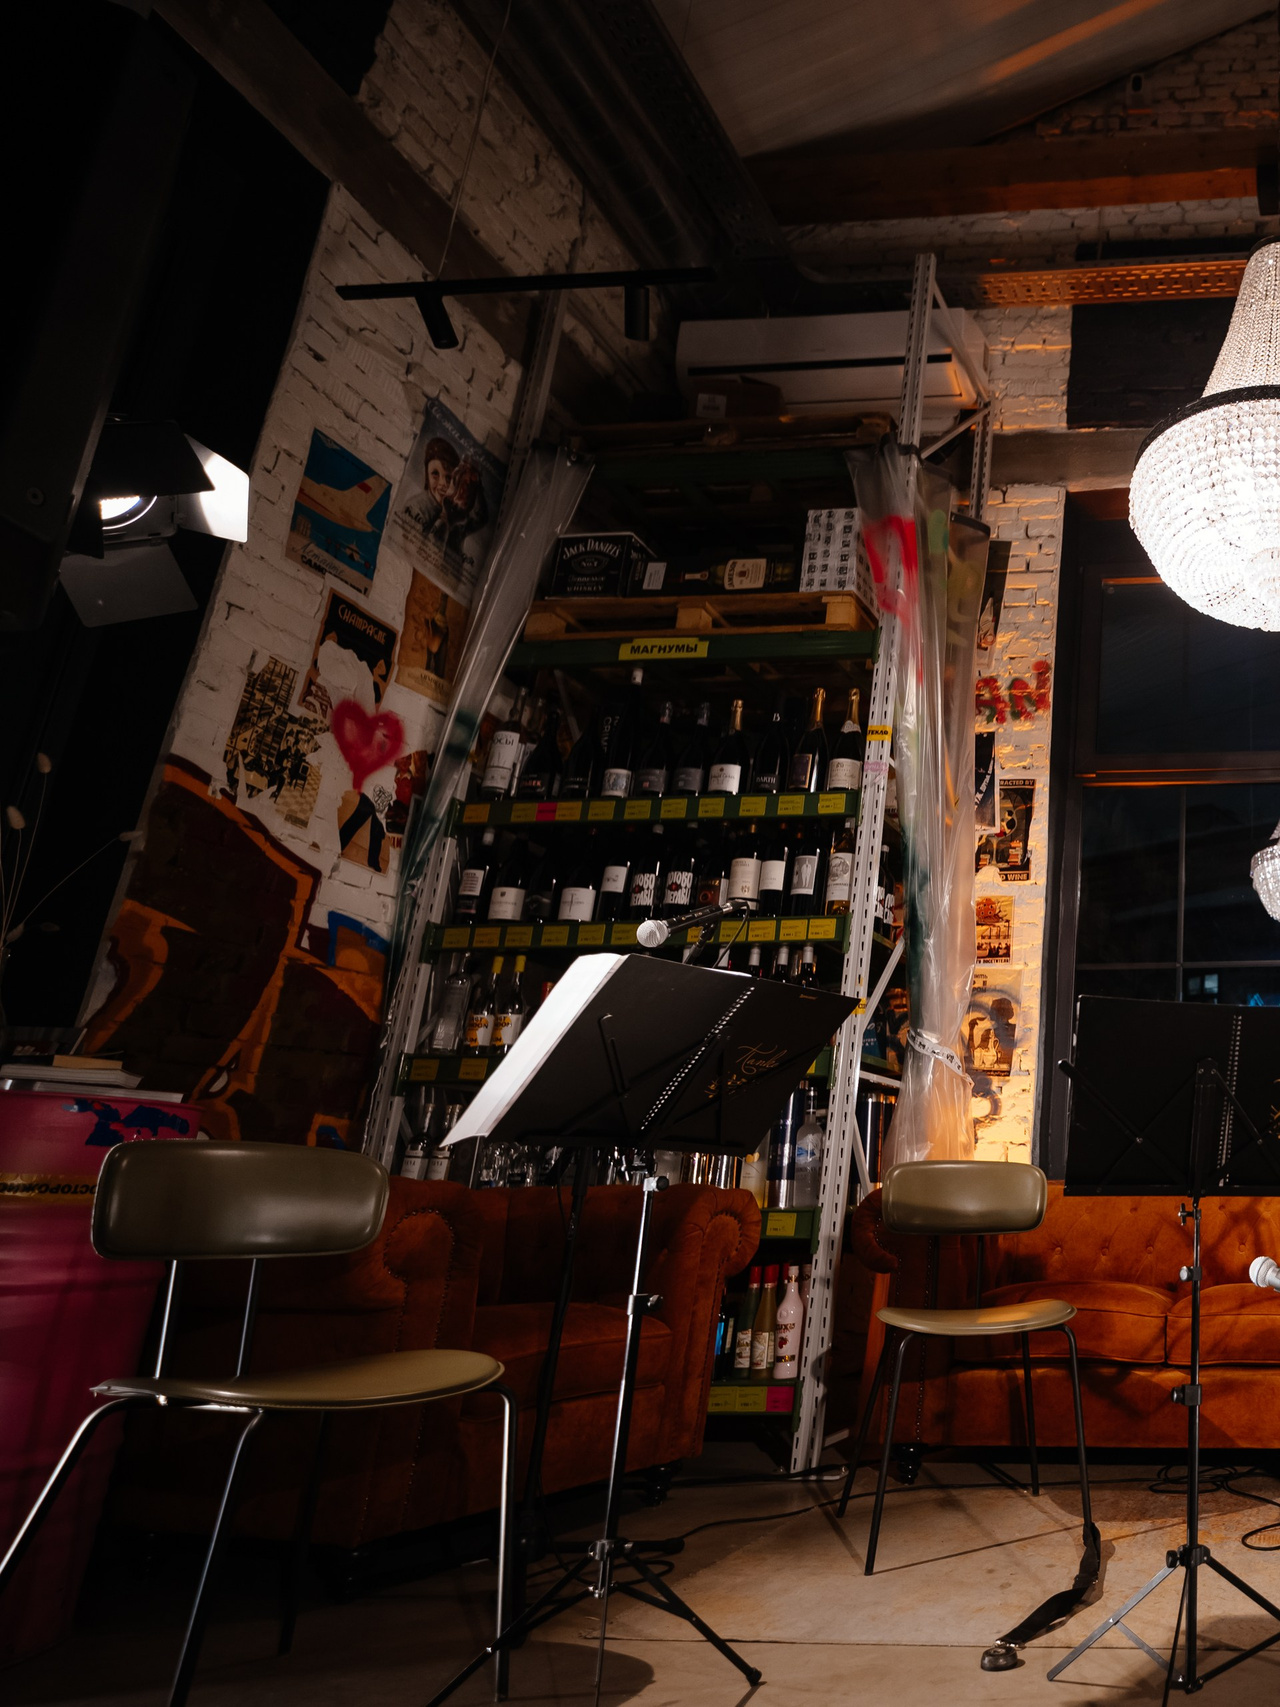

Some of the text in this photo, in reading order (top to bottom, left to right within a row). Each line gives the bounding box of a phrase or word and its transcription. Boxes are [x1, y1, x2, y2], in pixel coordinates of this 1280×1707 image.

[563, 542, 586, 560] JACK
[338, 602, 389, 645] CHAMPAGNE
[630, 644, 698, 655] МАГНУМЫ
[1007, 873, 1029, 881] WINE
